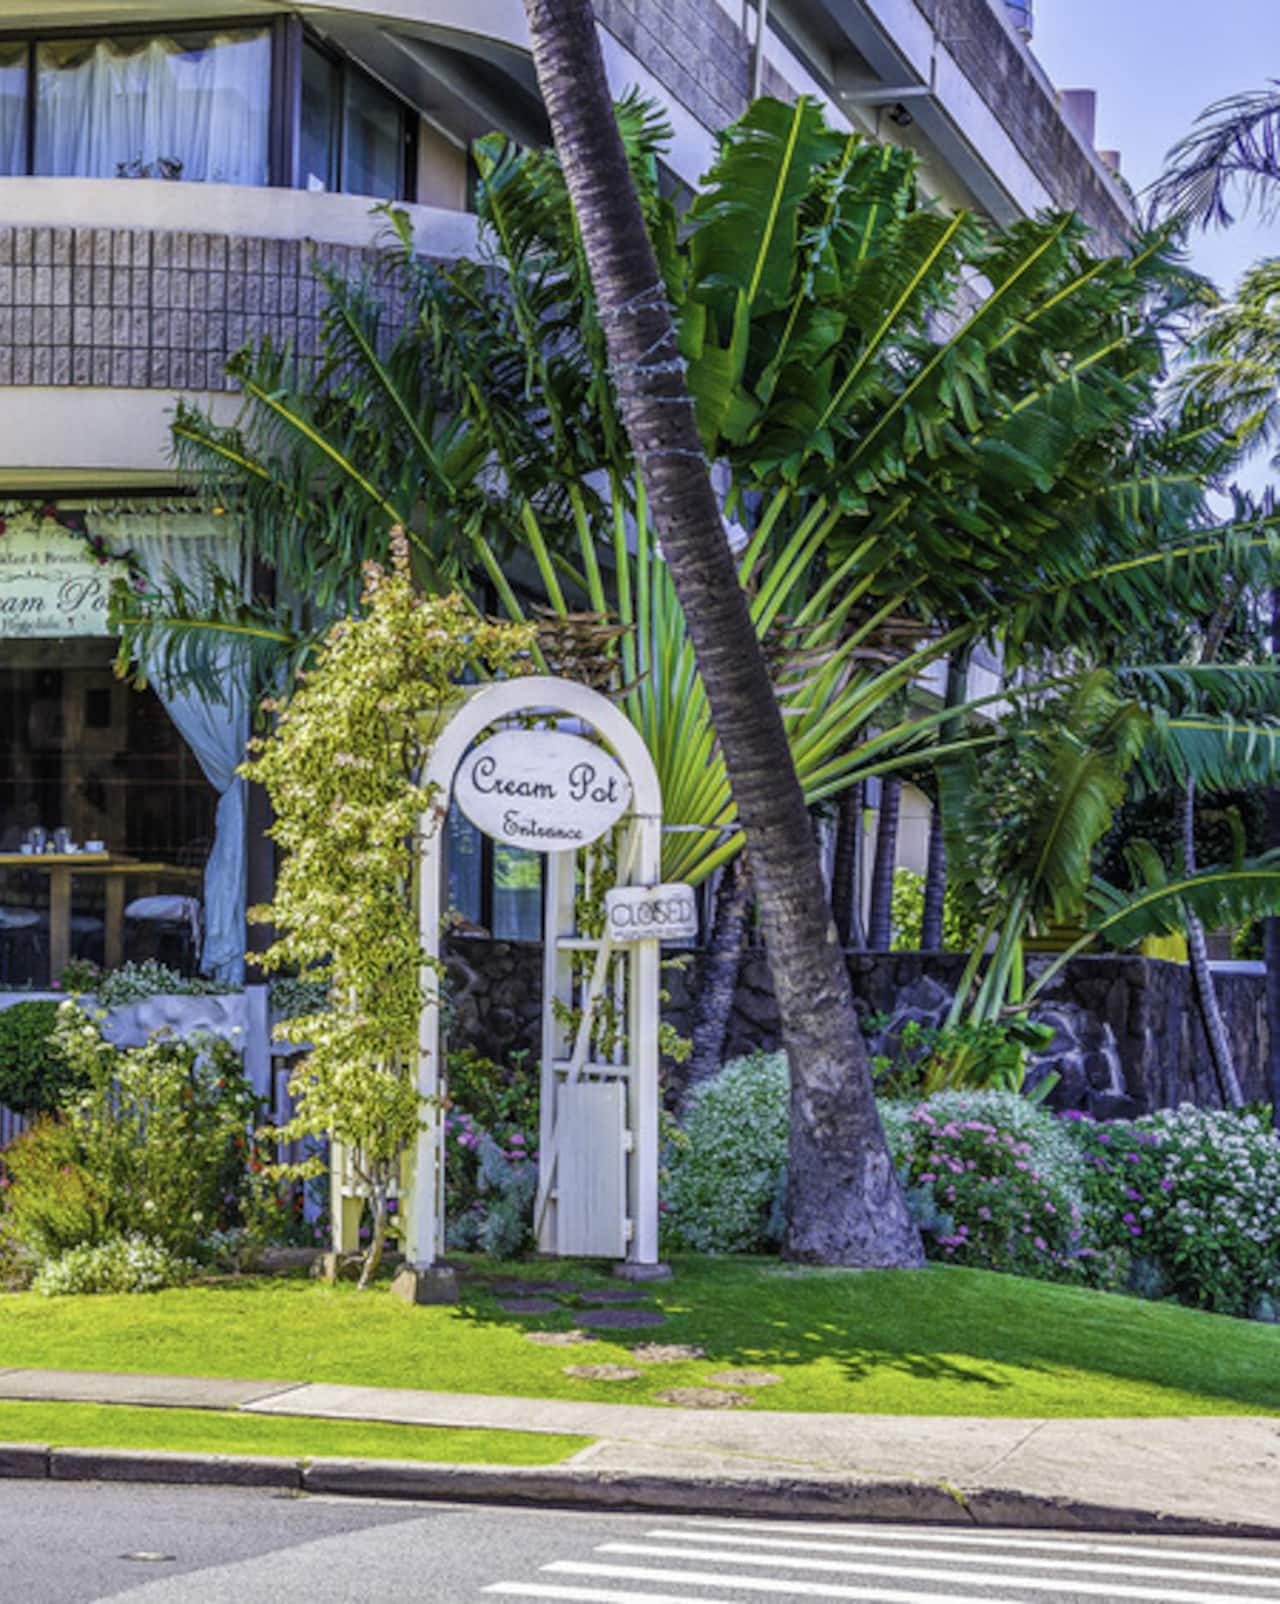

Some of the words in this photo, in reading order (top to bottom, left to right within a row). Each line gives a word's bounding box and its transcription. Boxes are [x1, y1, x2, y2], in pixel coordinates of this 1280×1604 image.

[56, 573, 109, 614] Po
[471, 756, 557, 800] Cream
[569, 762, 618, 803] Pot
[502, 810, 584, 840] Entrance
[611, 898, 693, 928] CLOSED
